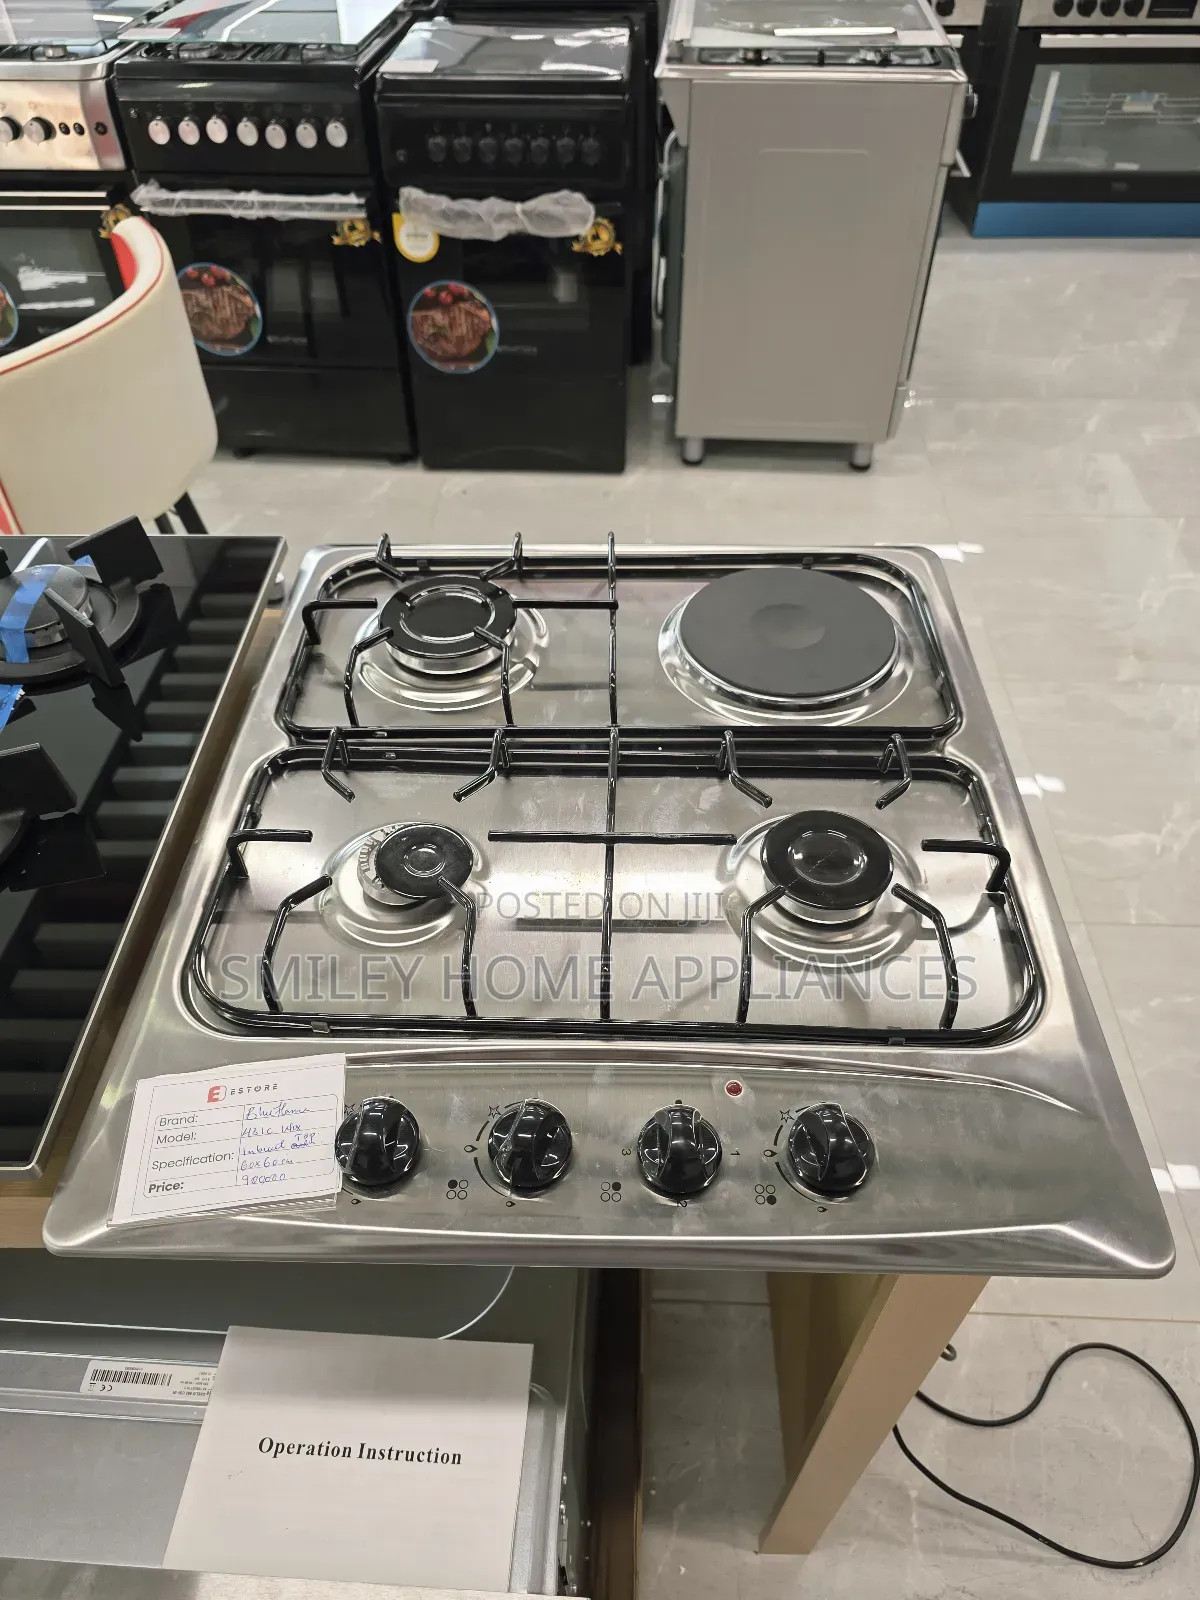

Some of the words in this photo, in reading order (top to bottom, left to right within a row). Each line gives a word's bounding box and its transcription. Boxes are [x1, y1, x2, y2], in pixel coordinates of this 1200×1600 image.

[230, 1083, 279, 1096] ESTORE
[159, 1114, 199, 1127] Brand:
[156, 1131, 197, 1145] Model:
[152, 1152, 235, 1172] Specification:
[148, 1181, 184, 1194] Price:
[258, 1436, 352, 1459] Operation
[356, 1442, 462, 1465] Instruction
